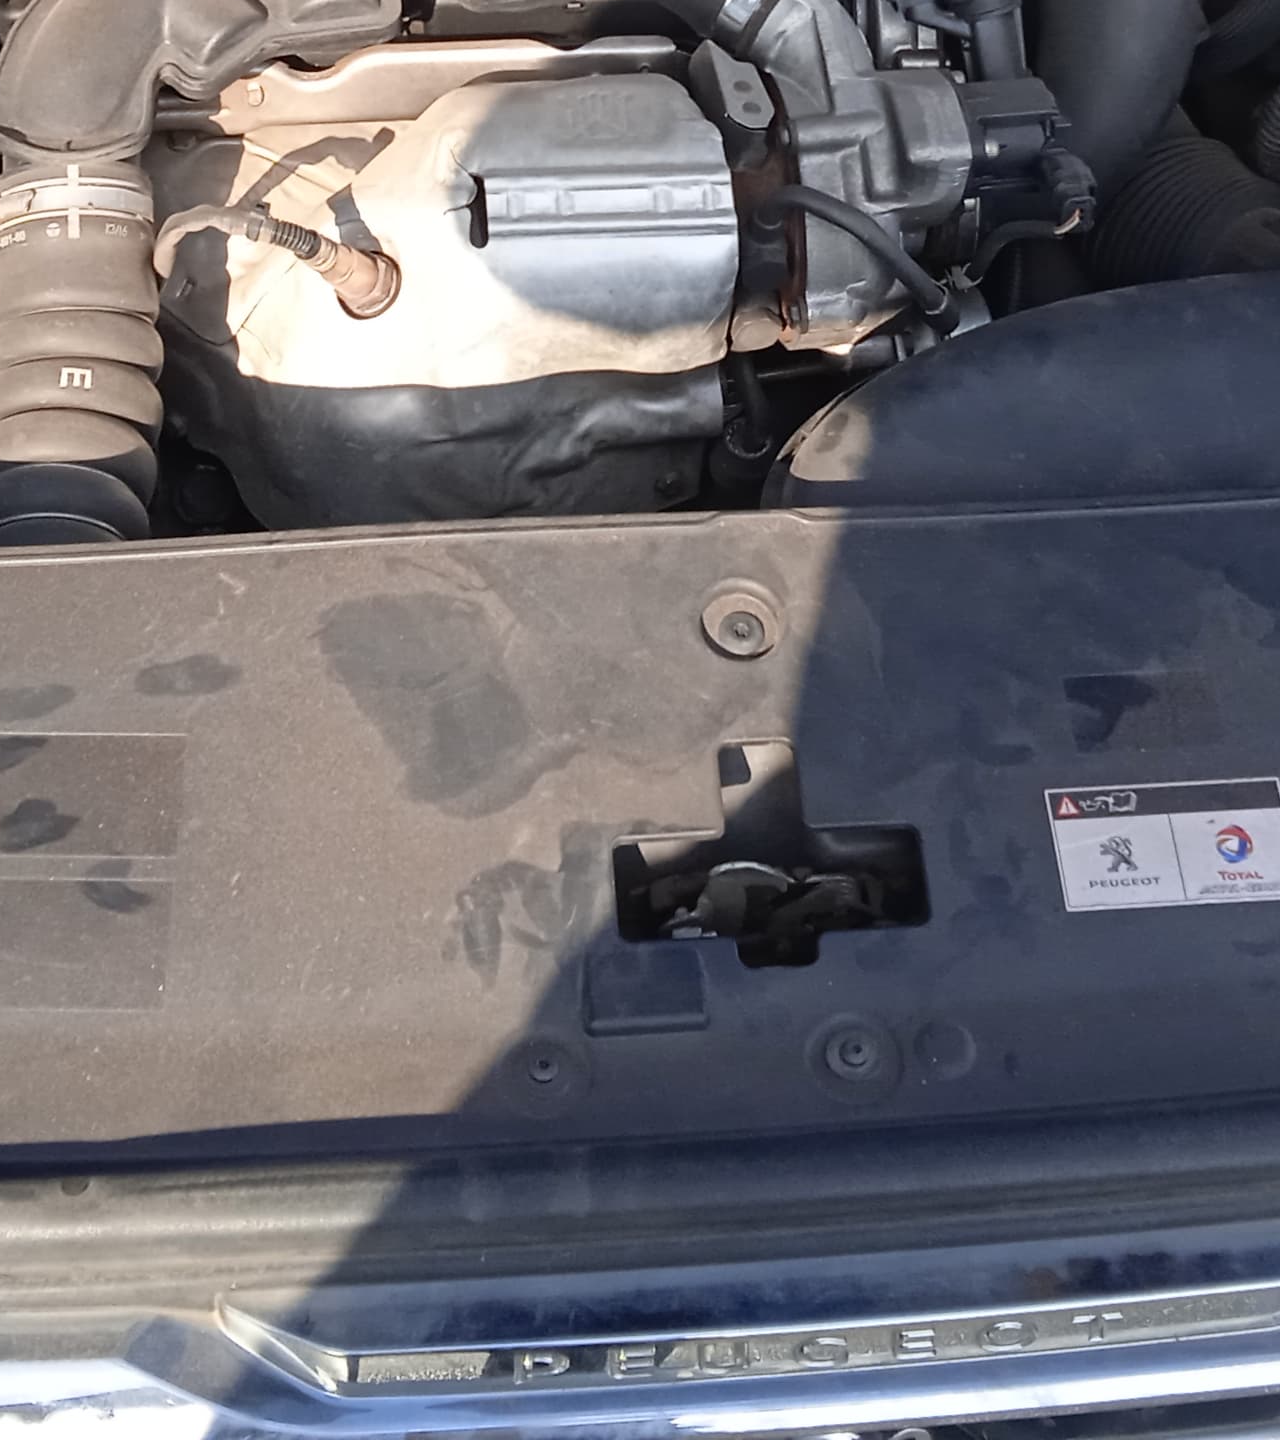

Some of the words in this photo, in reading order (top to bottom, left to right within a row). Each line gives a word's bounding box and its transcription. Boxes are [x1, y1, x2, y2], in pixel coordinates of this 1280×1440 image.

[58, 366, 93, 390] E
[1089, 876, 1160, 889] PEUGEOT
[1217, 870, 1264, 881] TOTAL
[513, 1312, 1124, 1384] PEUGEOT
